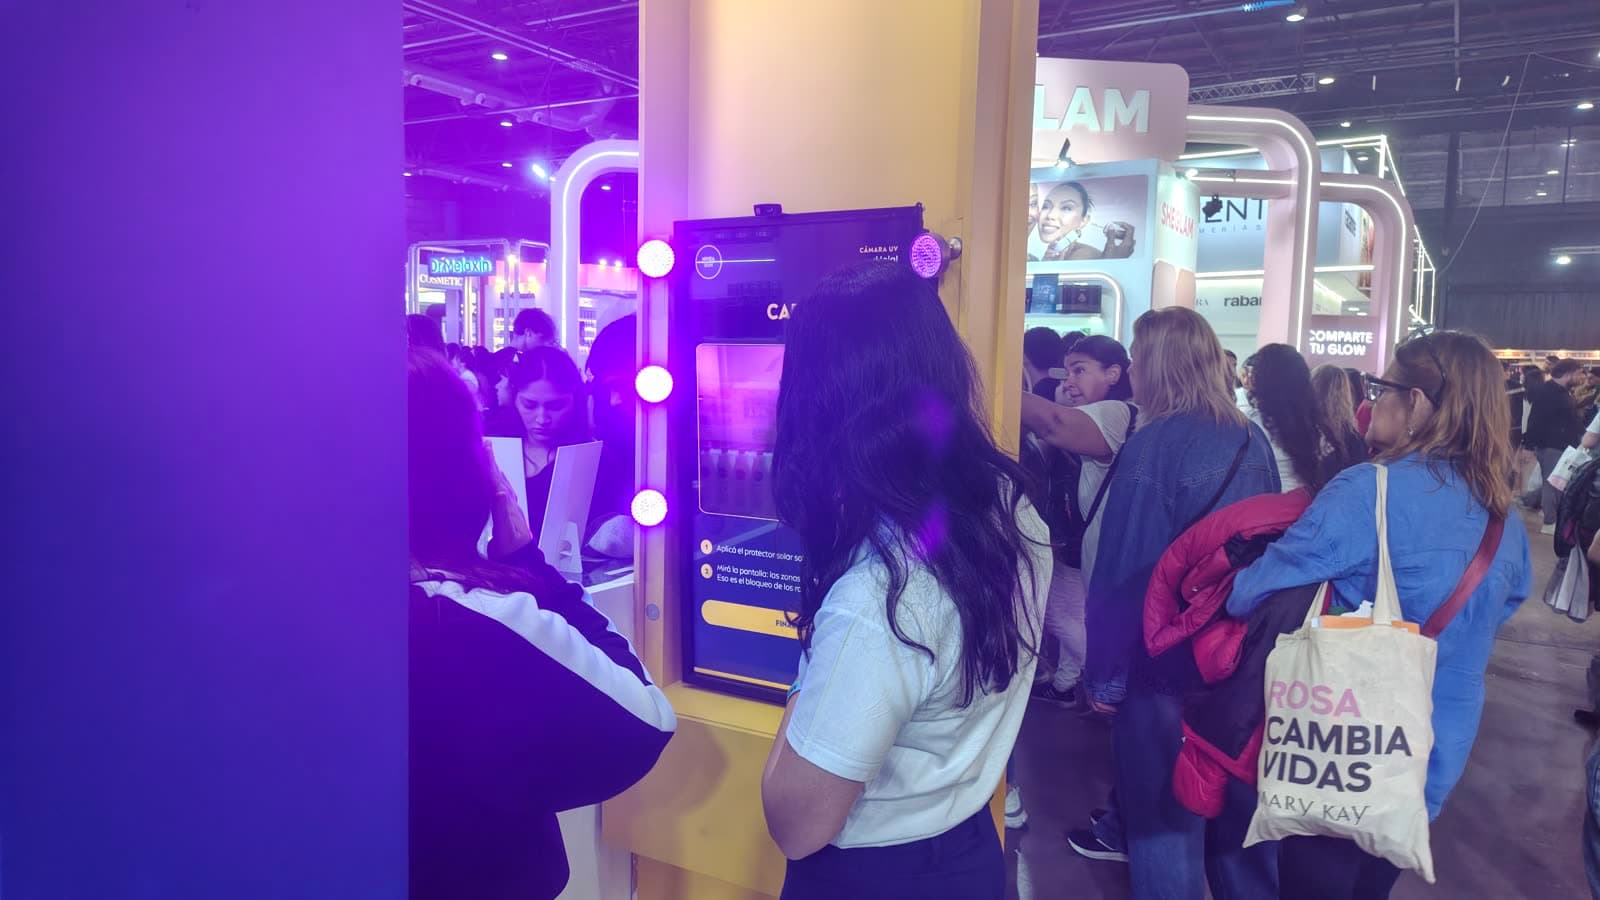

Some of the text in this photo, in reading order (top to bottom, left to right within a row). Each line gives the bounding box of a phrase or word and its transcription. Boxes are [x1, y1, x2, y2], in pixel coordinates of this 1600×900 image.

[1033, 84, 1150, 133] LAM
[1309, 342, 1367, 356] TU GLOW
[716, 545, 737, 554] Aplicá
[737, 547, 744, 555] el
[744, 549, 775, 560] protector
[776, 552, 793, 561] solar
[716, 564, 731, 573] Mirá
[740, 568, 769, 579] pantalla:
[770, 570, 780, 580] las
[780, 574, 801, 583] zonas
[716, 573, 729, 582] Eso
[738, 577, 745, 585] el
[745, 578, 773, 589] bloqueo
[773, 581, 783, 590] de
[783, 582, 794, 592] los
[1269, 679, 1362, 718] ROSA
[1267, 715, 1413, 757] CAMBIA
[1263, 749, 1373, 793] VIDAS
[1322, 804, 1371, 826] KAY
